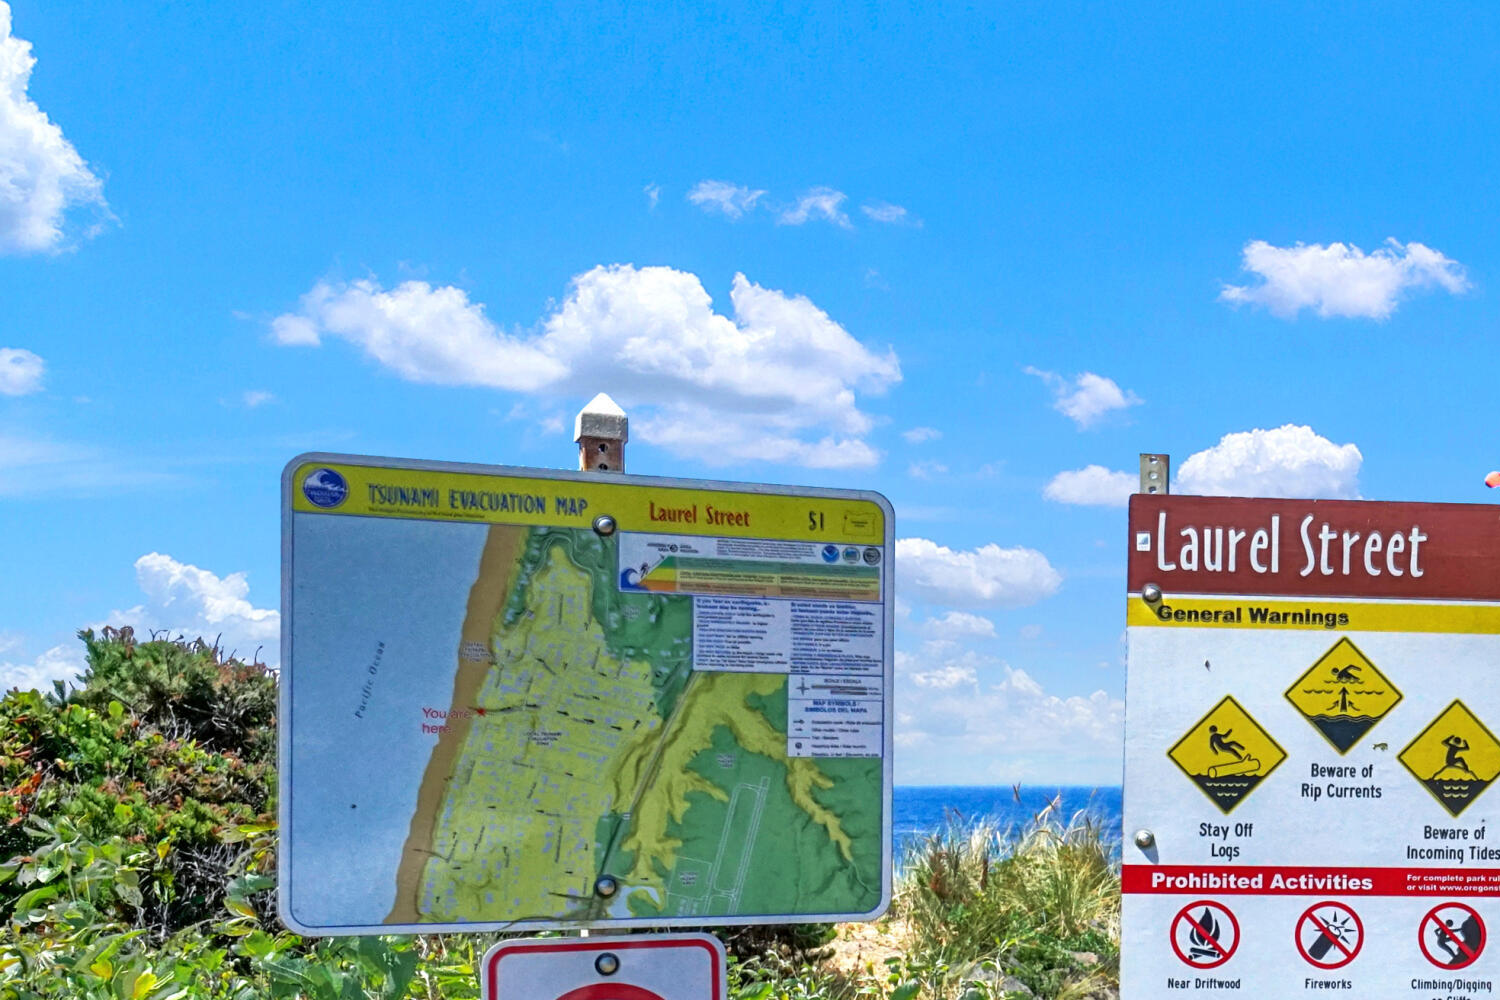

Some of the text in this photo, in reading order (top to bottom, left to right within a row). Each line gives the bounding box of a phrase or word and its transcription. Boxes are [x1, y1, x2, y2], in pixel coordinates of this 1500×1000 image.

[368, 484, 440, 508] TSUNAMI
[450, 488, 546, 514] EVACUATION
[555, 498, 588, 517] MAP
[650, 502, 750, 528] Laurel Street
[1156, 512, 1428, 578] Laurel Street
[1156, 606, 1350, 629] General Warnings
[354, 641, 386, 719] Pacific Ocean
[422, 708, 470, 719] You are
[422, 723, 450, 734] here
[1311, 763, 1374, 779] Beware of
[1301, 783, 1382, 802] Rip Currents
[1199, 822, 1254, 841] Stay Off
[1424, 826, 1486, 842] Beware of
[1210, 844, 1240, 860] Logs
[1406, 846, 1464, 864] Incoming
[1151, 872, 1373, 891] Prohibited Activities
[1423, 875, 1464, 883] complete
[1467, 875, 1486, 883] park
[1167, 978, 1241, 990] Near Driftwood
[1305, 978, 1352, 990] Fireworks
[1411, 978, 1492, 994] Climbing/Digging
